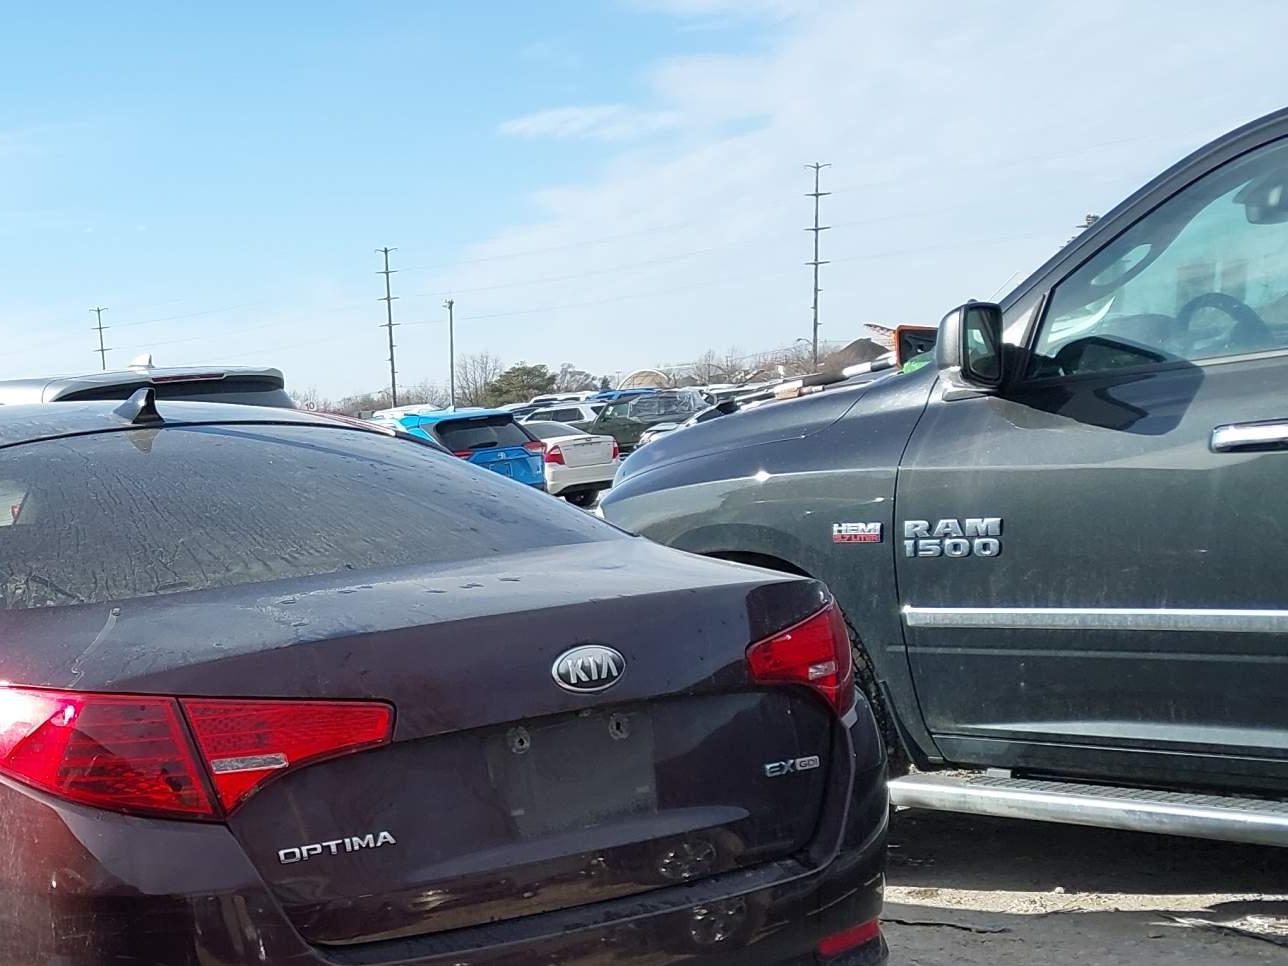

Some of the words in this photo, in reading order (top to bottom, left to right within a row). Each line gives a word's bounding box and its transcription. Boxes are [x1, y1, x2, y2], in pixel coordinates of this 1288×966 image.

[832, 522, 882, 534] HEMI
[904, 517, 1002, 538] RAM
[852, 534, 880, 542] LITER
[903, 538, 1000, 558] 1500
[566, 652, 619, 684] KIA
[765, 759, 795, 777] EX
[277, 831, 398, 864] OPTIMA
